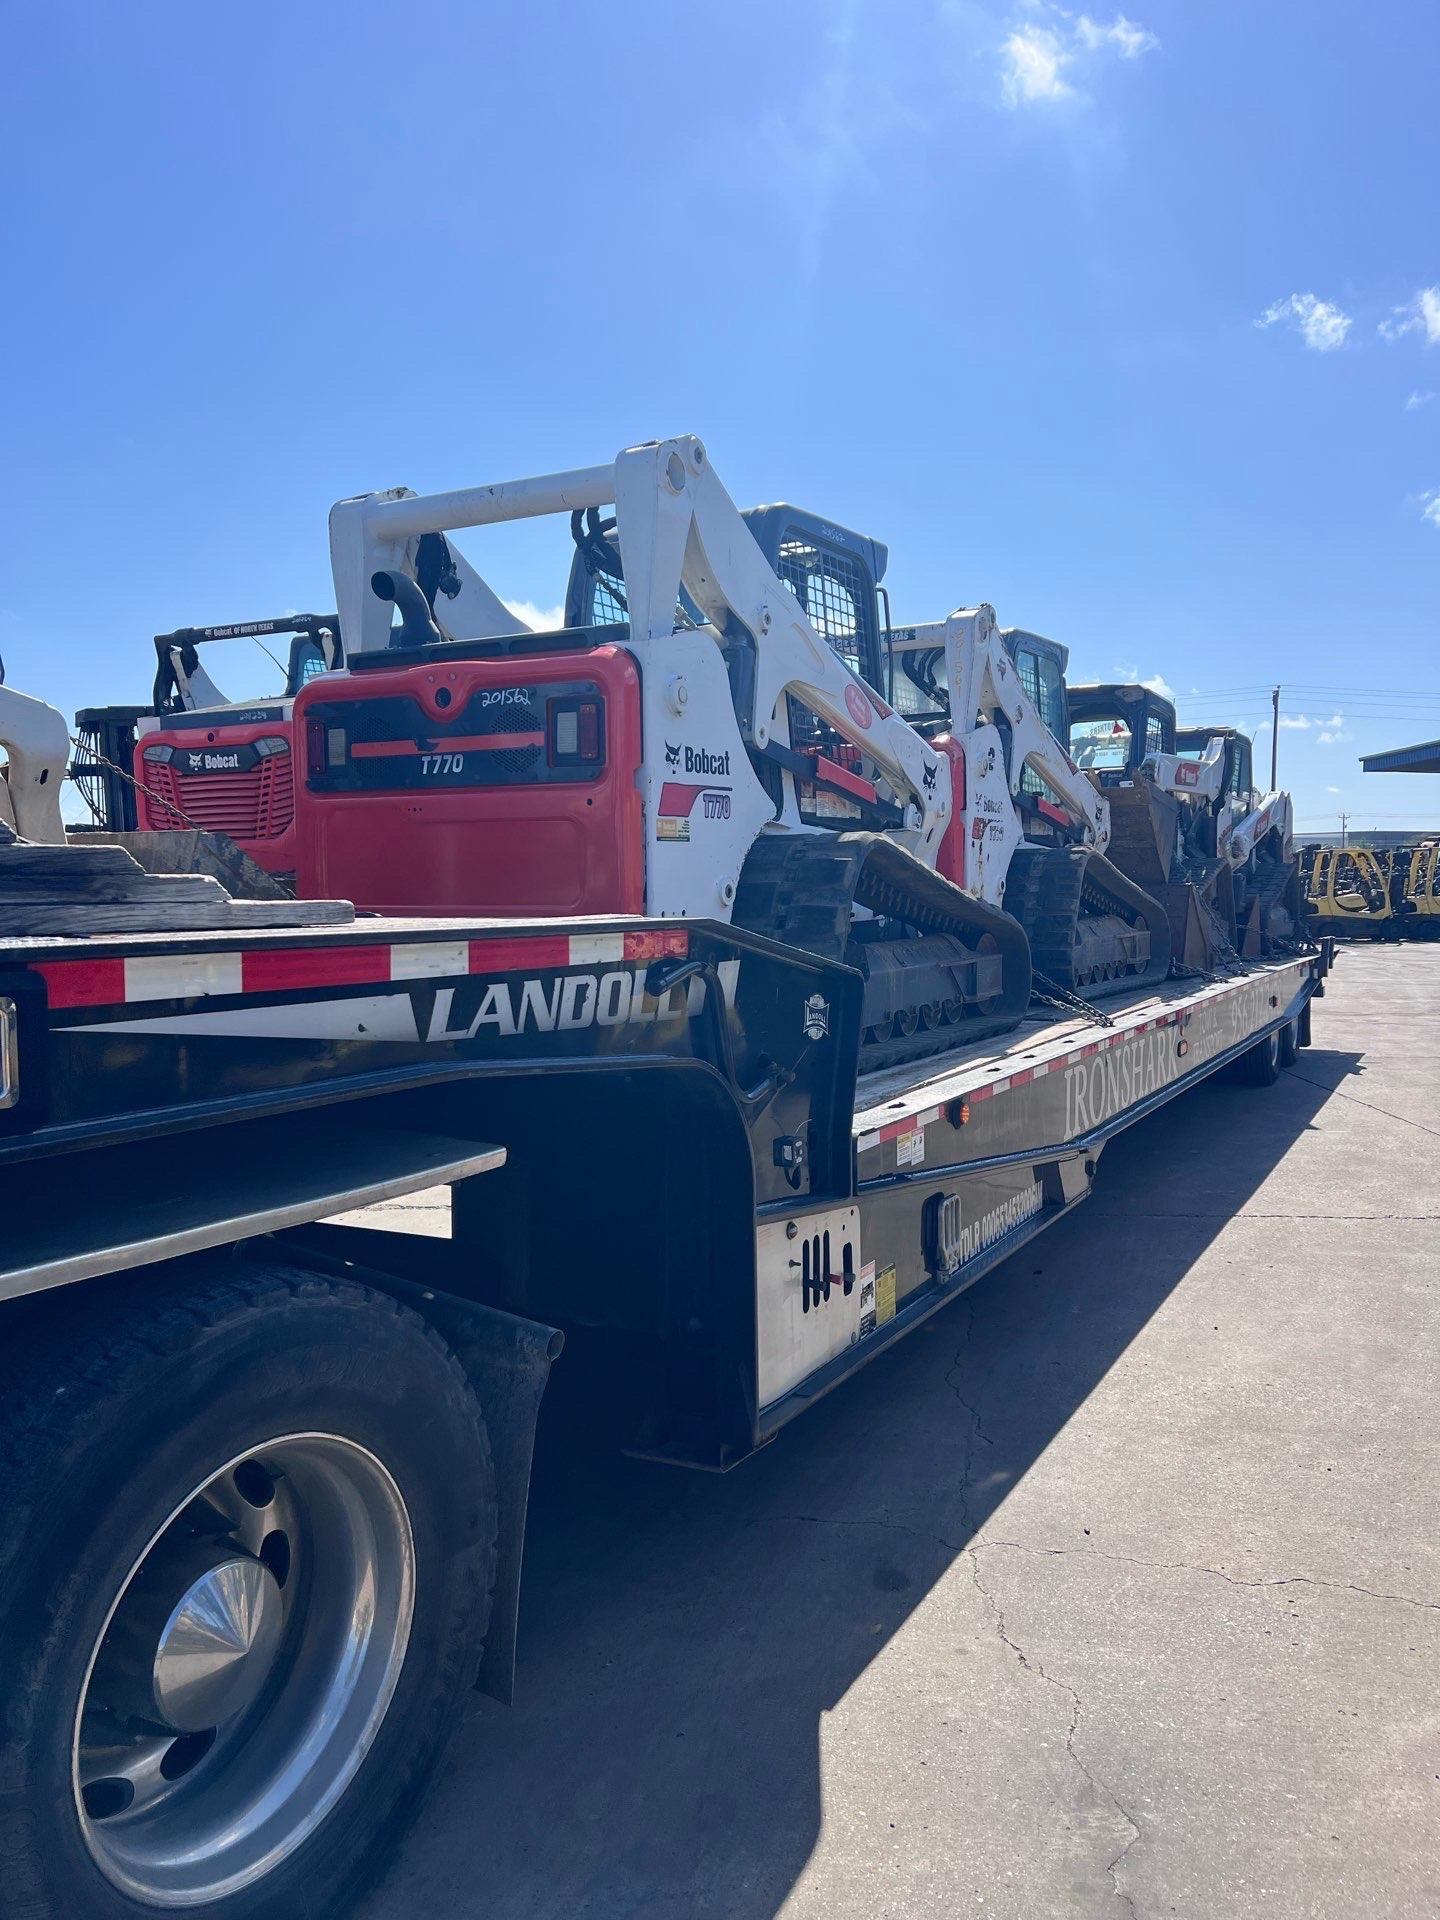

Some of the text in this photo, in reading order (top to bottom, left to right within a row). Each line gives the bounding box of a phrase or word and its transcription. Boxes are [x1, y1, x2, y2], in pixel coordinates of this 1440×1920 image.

[481, 688, 531, 707] 201562
[205, 753, 239, 769] Bobcat
[421, 754, 464, 775] T770
[685, 746, 730, 775] Bobcat
[703, 793, 731, 819] T770
[426, 966, 682, 1043] LANDOLL
[1064, 1024, 1179, 1142] IRONSHARK
